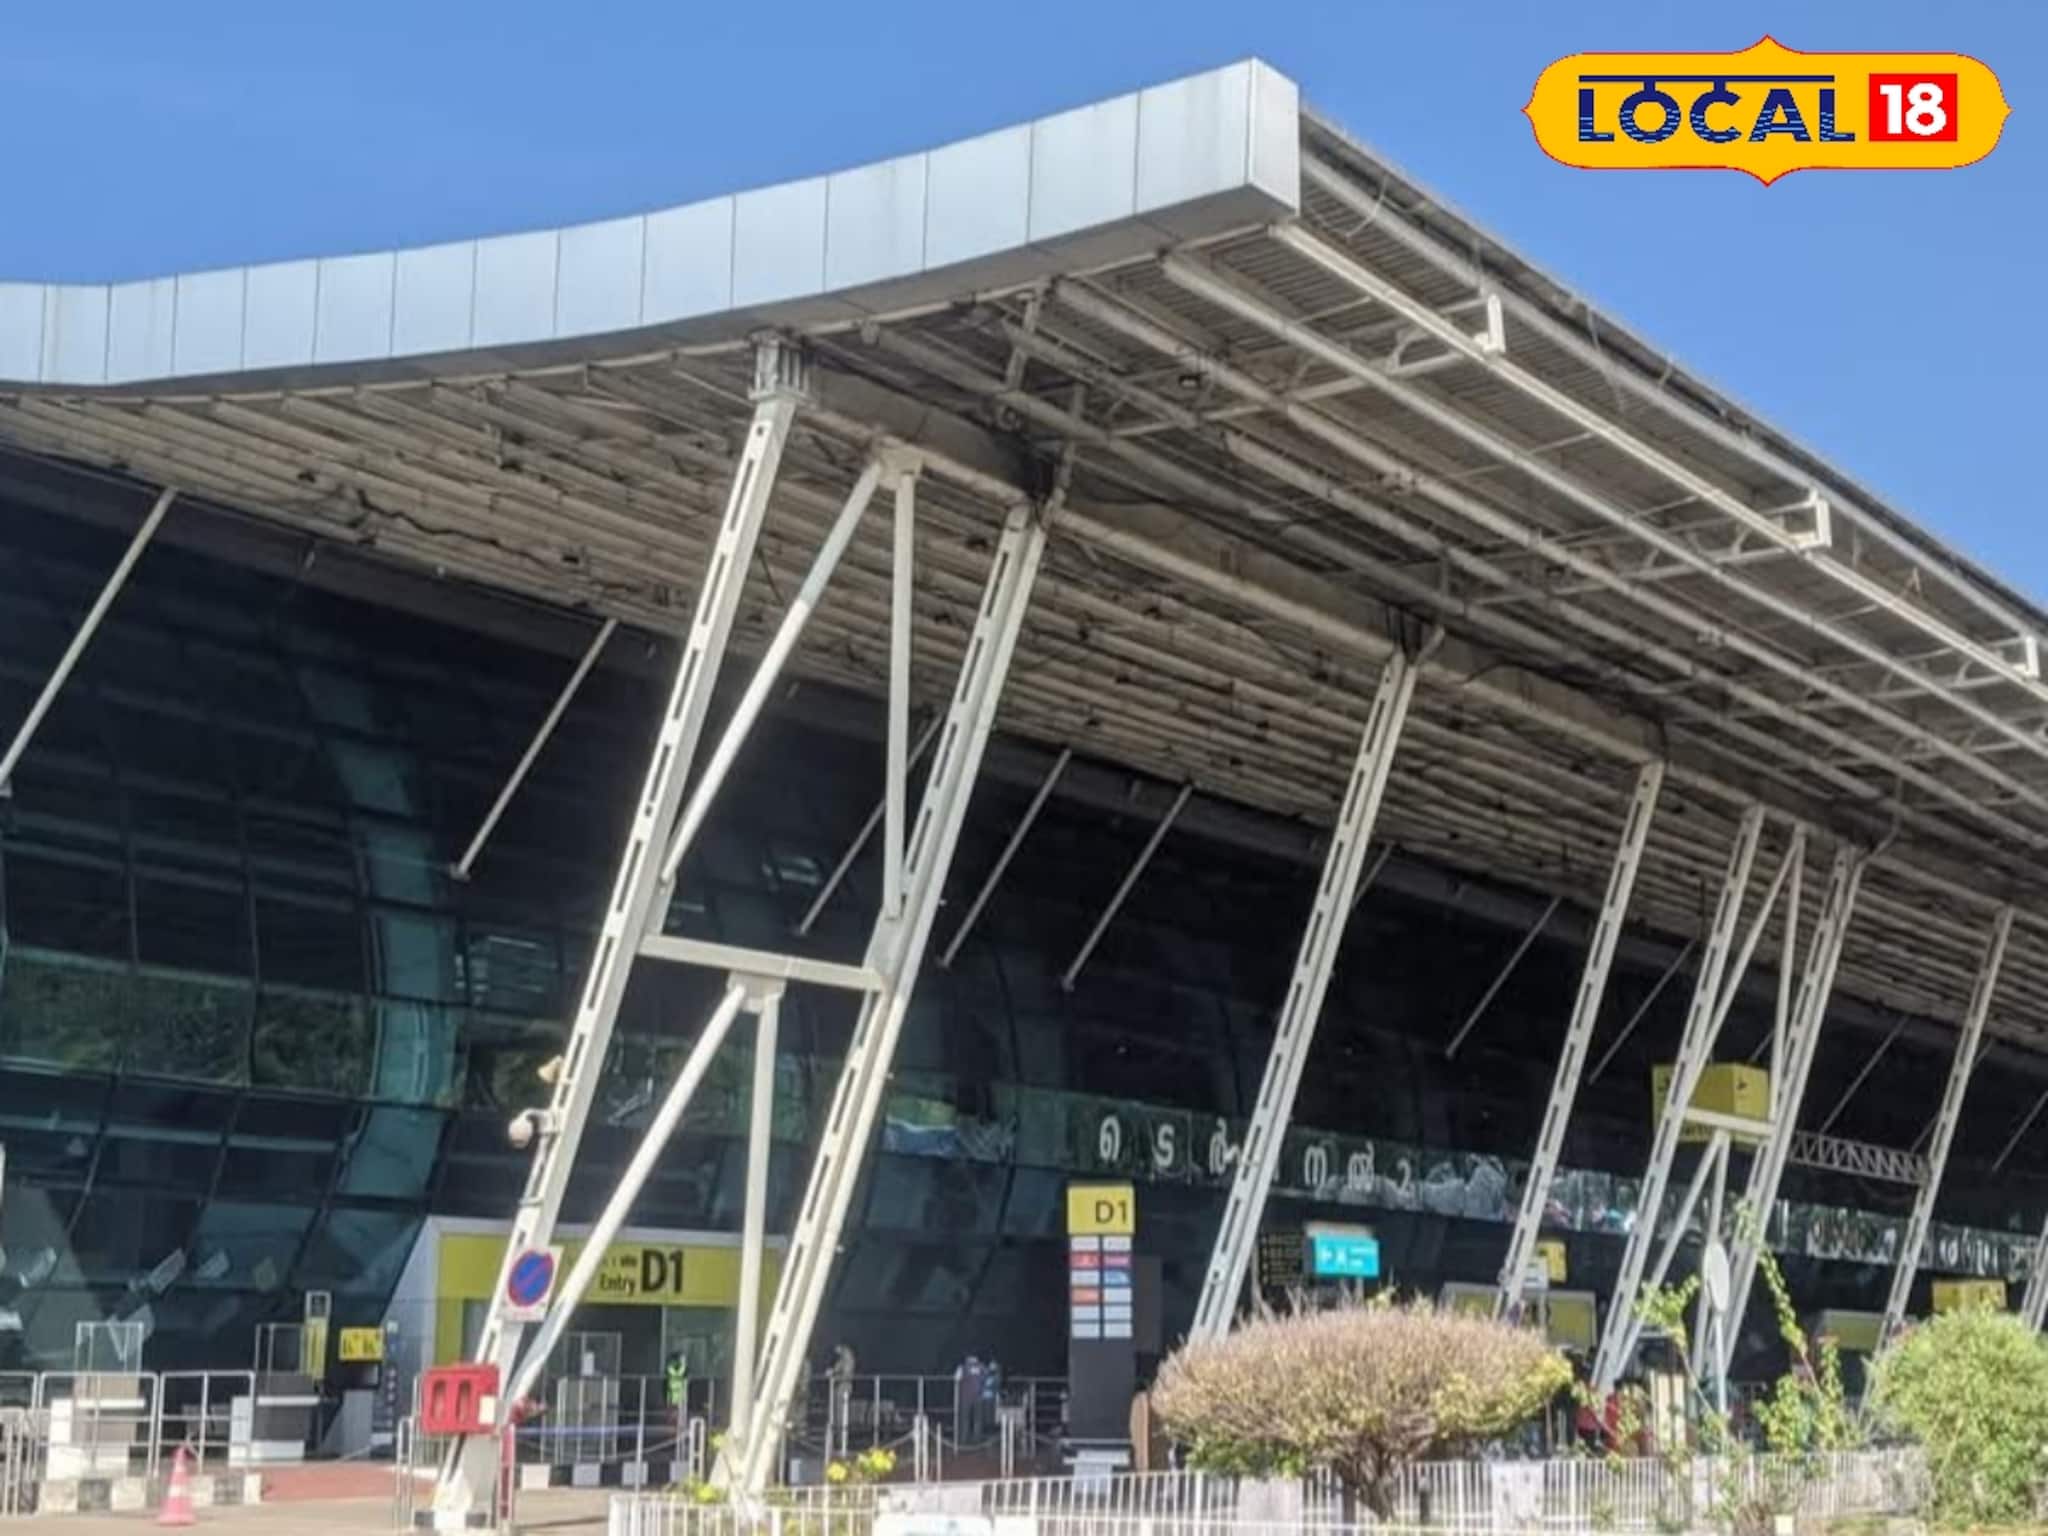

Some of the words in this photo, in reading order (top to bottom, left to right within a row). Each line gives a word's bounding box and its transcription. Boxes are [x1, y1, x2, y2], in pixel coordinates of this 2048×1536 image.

[1095, 1201, 1128, 1225] D1
[600, 1273, 636, 1297] Entry
[641, 1248, 684, 1293] D1
